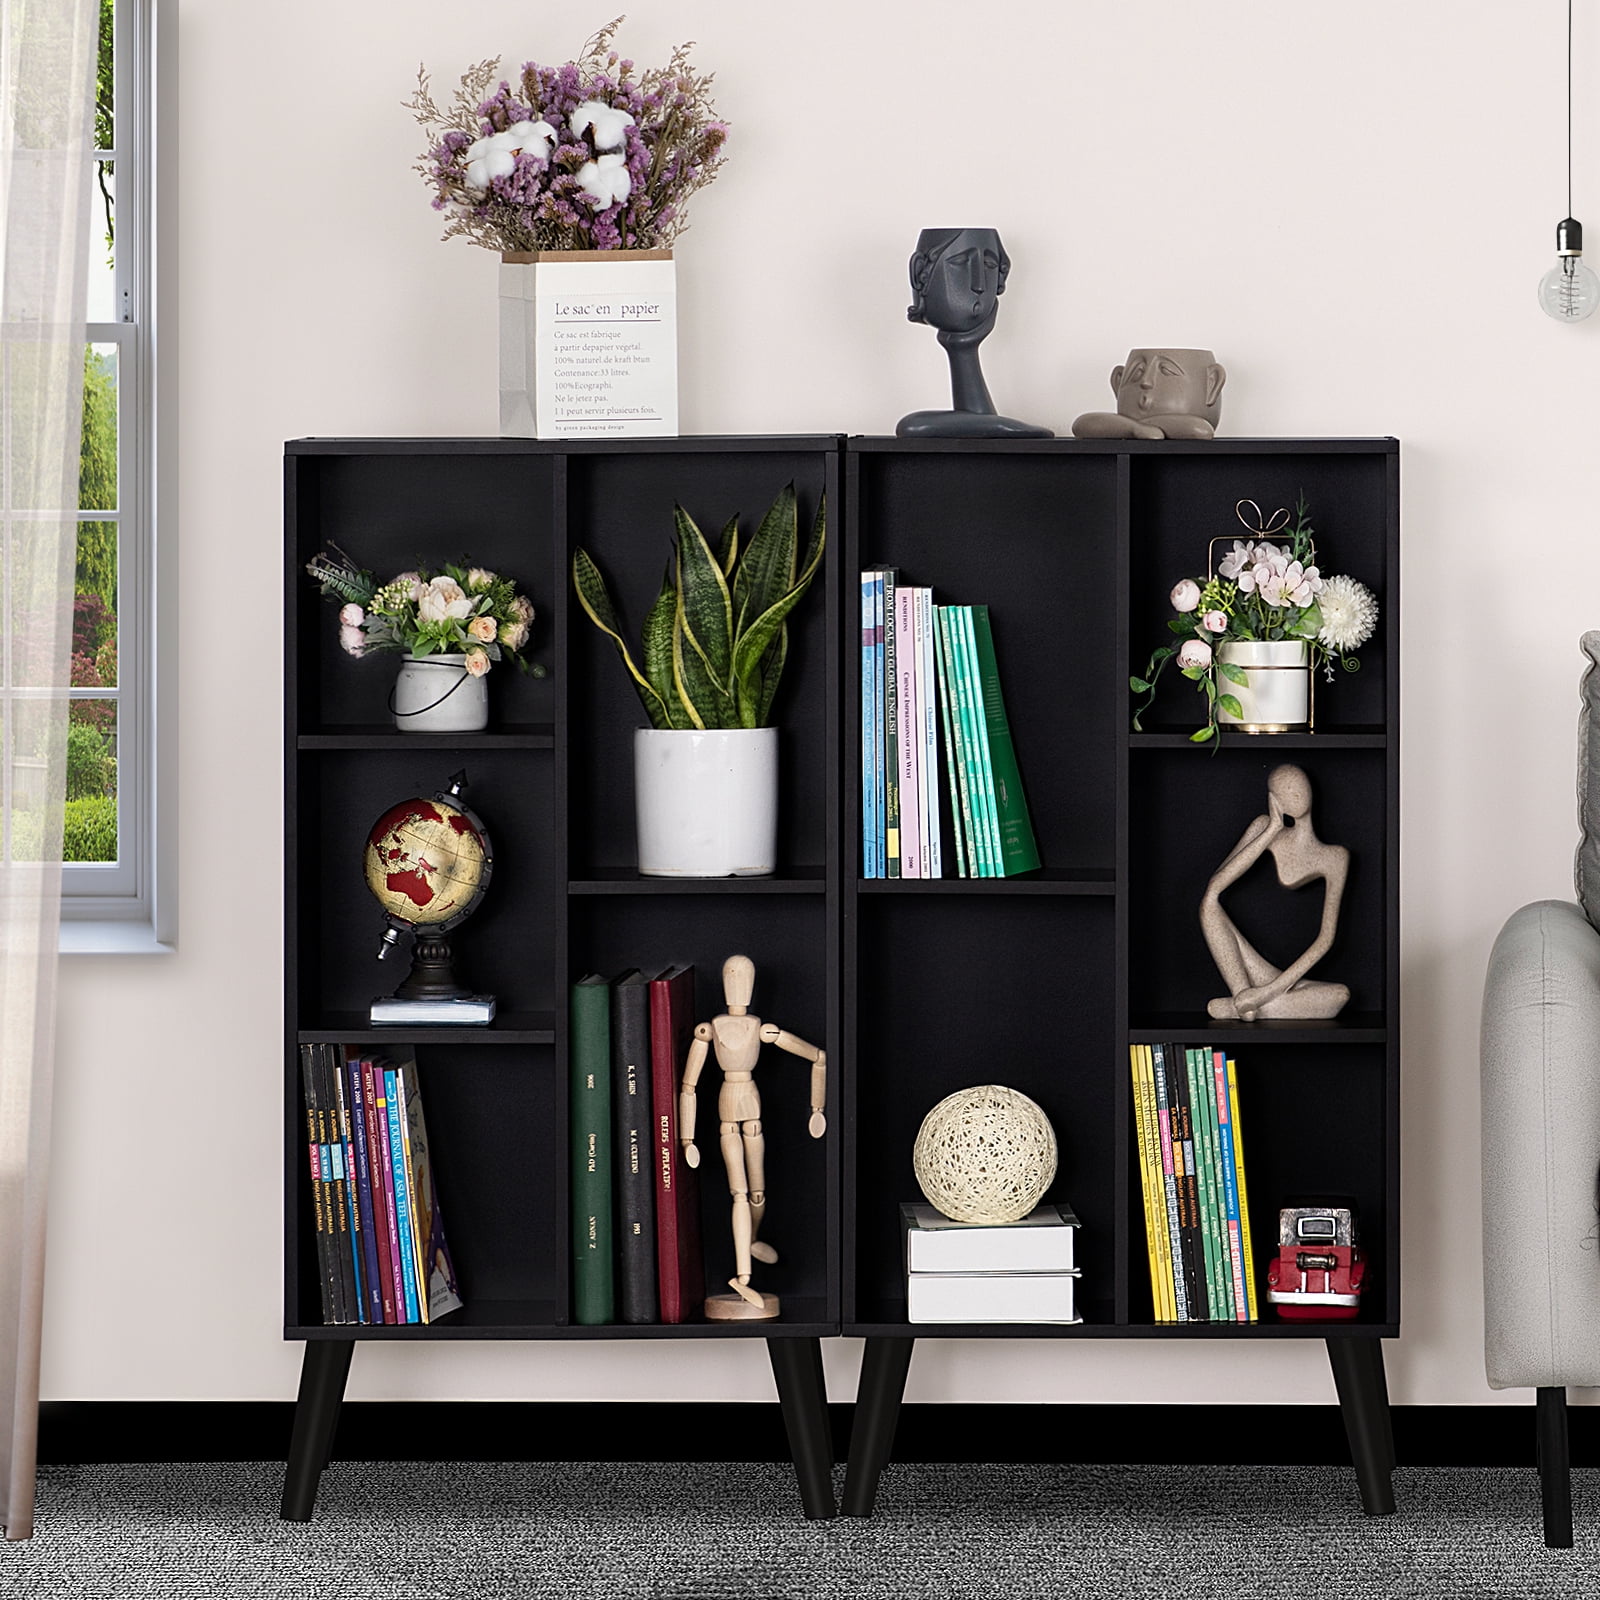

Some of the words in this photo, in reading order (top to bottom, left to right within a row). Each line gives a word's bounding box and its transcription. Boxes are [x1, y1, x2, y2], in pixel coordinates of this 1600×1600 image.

[556, 303, 570, 315] Le
[596, 304, 610, 314] en
[621, 302, 660, 318] papier
[591, 330, 621, 340] fabrique
[560, 344, 580, 353] partir
[567, 408, 583, 416] peut
[607, 406, 639, 416] plusieurs
[886, 585, 894, 610] FROM
[887, 613, 895, 643] LOCAL
[887, 646, 895, 657] TO
[887, 659, 895, 695] GLOBAL
[888, 697, 896, 735] ENGLISH
[1205, 1060, 1213, 1078] Asian
[364, 1073, 372, 1091] IATEFL
[1141, 1081, 1150, 1103] ASIAN
[1156, 1067, 1165, 1102] JOURNAL
[1189, 1080, 1198, 1109] Englishes
[1206, 1078, 1216, 1106] Englishes
[318, 1110, 324, 1118] EA
[344, 1109, 350, 1117] EA
[367, 1110, 376, 1134] Aberdeen
[389, 1104, 399, 1121] THE
[1143, 1105, 1152, 1136] STUDIES
[1171, 1107, 1177, 1115] EA
[357, 1125, 366, 1153] Conference
[370, 1136, 378, 1162] Conference
[391, 1124, 402, 1160] JOURNAL
[313, 1164, 319, 1172] NO
[322, 1165, 329, 1174] NO
[359, 1154, 368, 1179] Selections
[372, 1164, 380, 1188] Selections
[394, 1163, 403, 1176] OF
[395, 1180, 405, 1198] ASIA
[316, 1202, 324, 1231] AUSTRALIA
[326, 1205, 334, 1235] AUSTRALIA
[338, 1203, 346, 1232] AUSTRALIA
[352, 1203, 360, 1231] AUSTRALIA
[397, 1201, 406, 1220] TEFL
[1179, 1199, 1188, 1228] AUSTRALIA
[1190, 1199, 1198, 1229] AUSTRALIA
[589, 1215, 597, 1241] ADNAN
[1229, 1229, 1243, 1279] WORLD-WIDE
[1214, 1260, 1224, 1290] Englishes
[1234, 1280, 1246, 1313] ENGLISH
